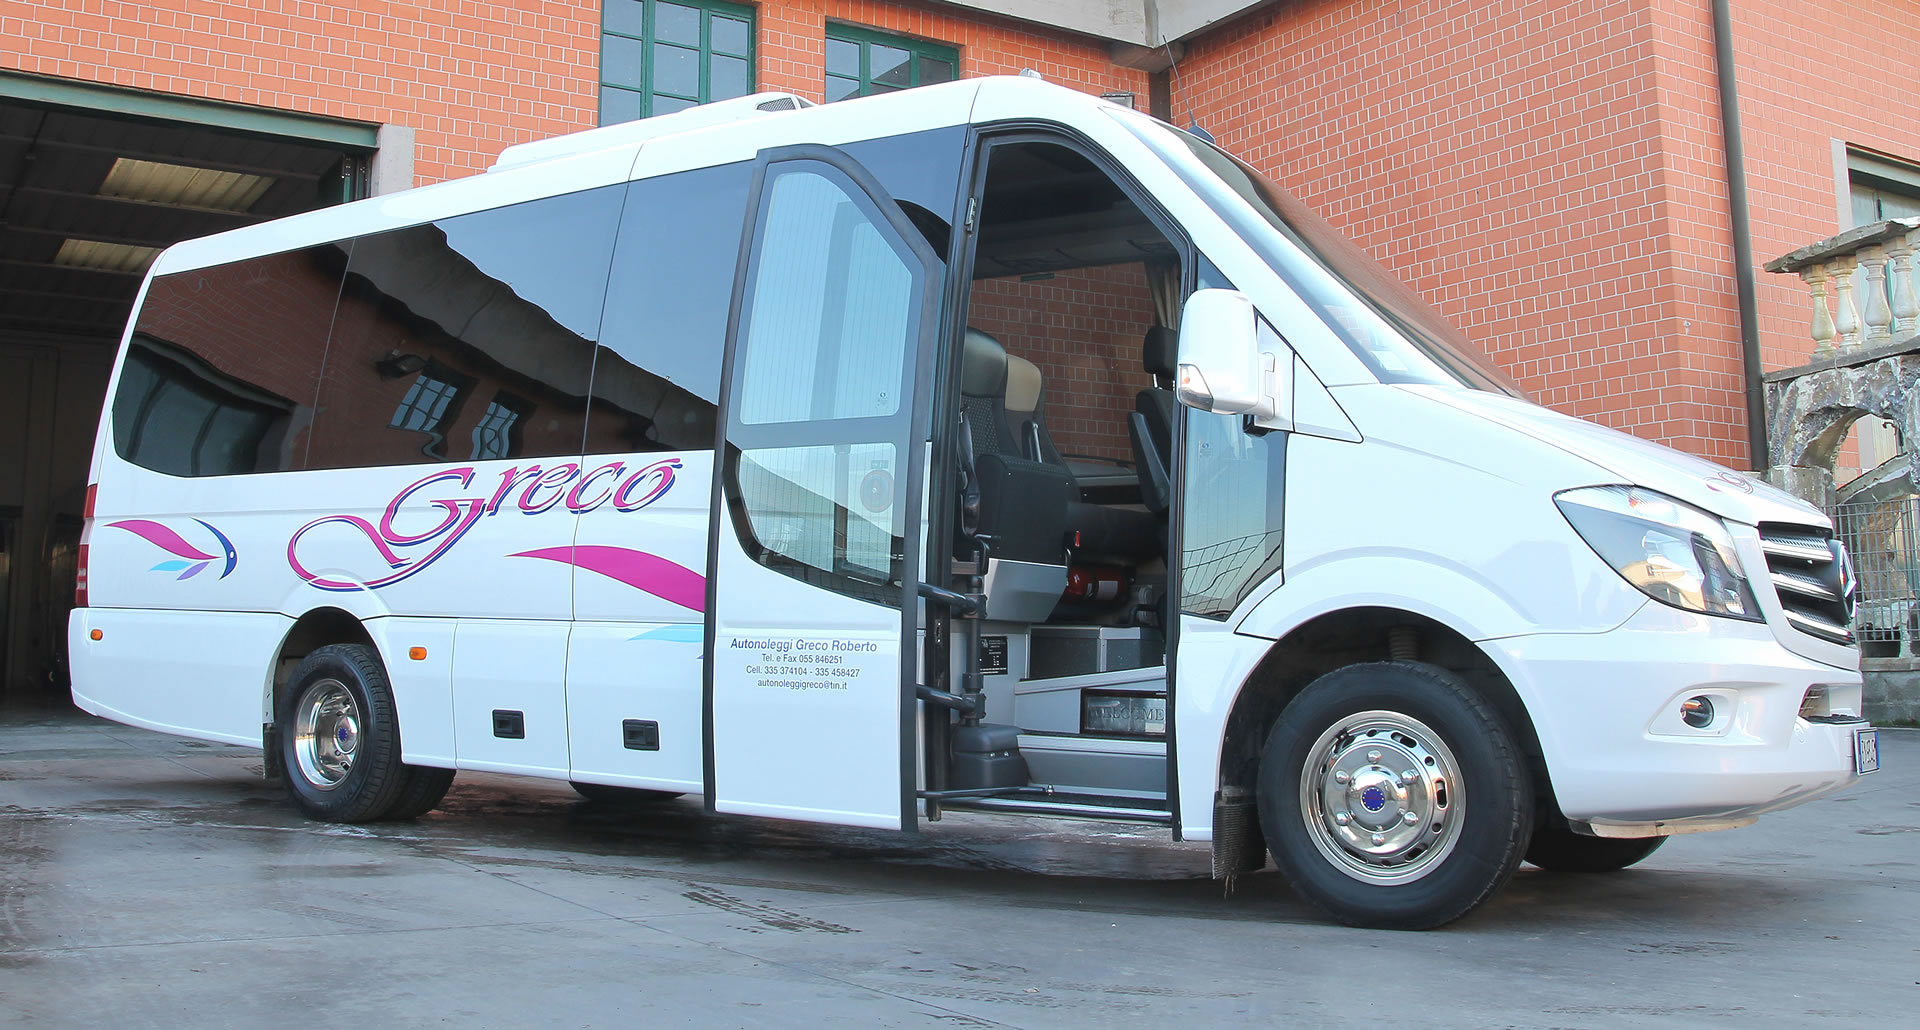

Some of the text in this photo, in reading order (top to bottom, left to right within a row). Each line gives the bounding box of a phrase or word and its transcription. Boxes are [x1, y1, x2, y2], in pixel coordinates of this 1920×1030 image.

[287, 458, 684, 592] Greco
[730, 638, 878, 652] Autonoleggi Greco Roberto
[762, 653, 774, 662] Tel.
[783, 654, 797, 663] Fax
[799, 654, 813, 663] 055
[815, 655, 843, 664] 846251
[746, 665, 762, 674] Cell.
[764, 666, 778, 675] 335
[780, 666, 807, 675] 374104
[815, 667, 829, 676] 335
[831, 668, 860, 677] 458427
[757, 678, 848, 690] autonoleggigreco@tin.it
